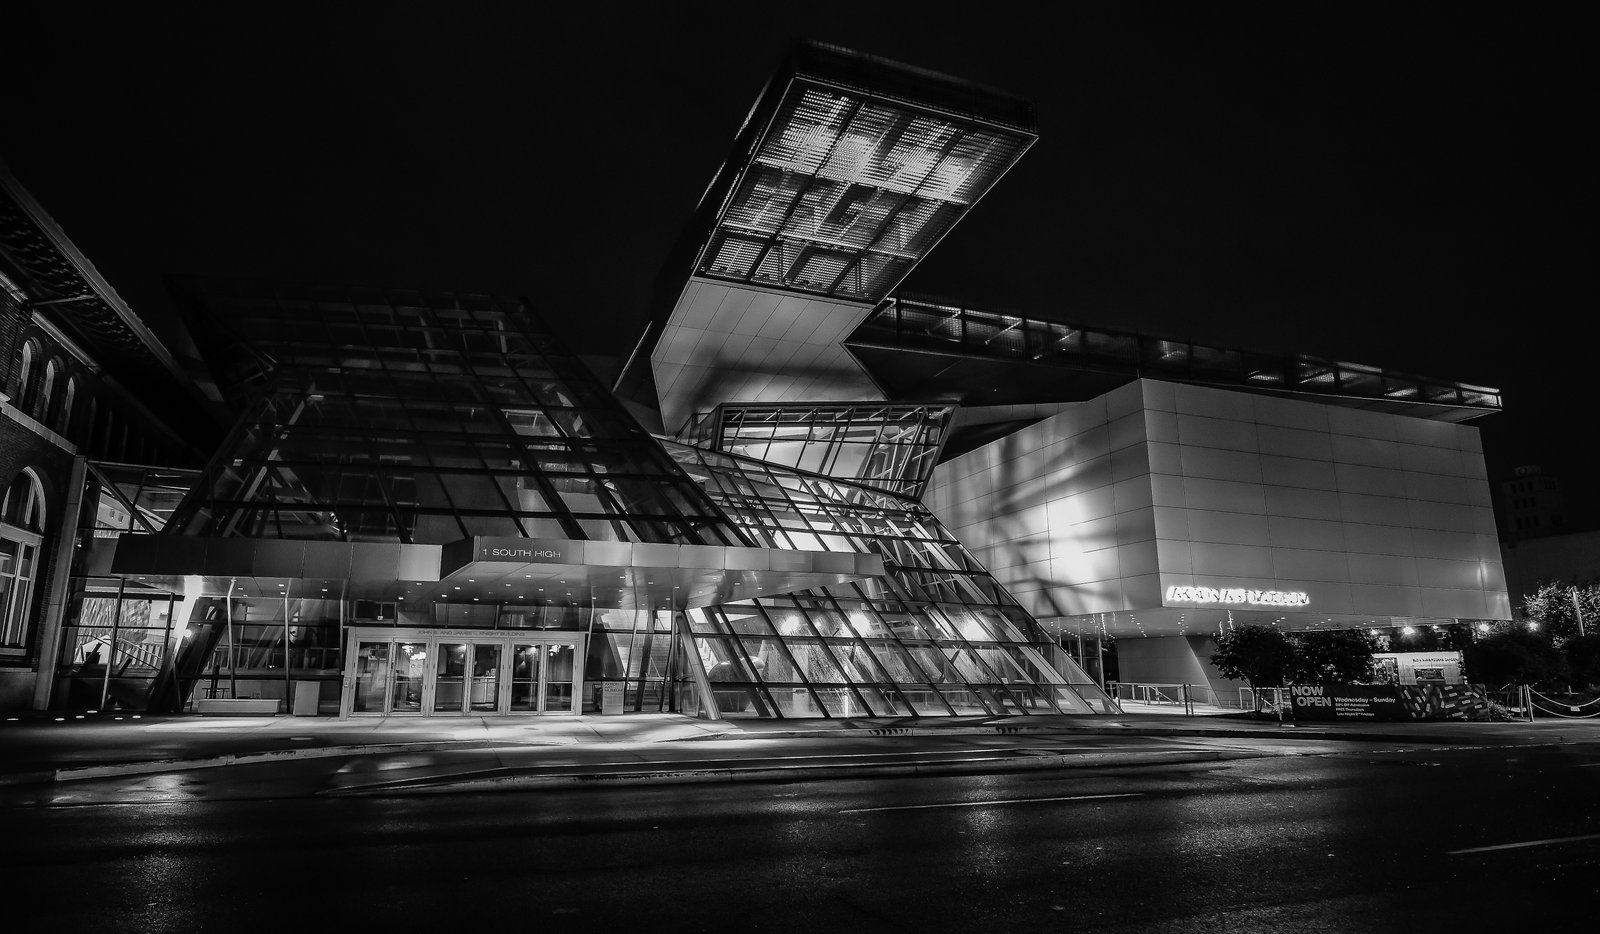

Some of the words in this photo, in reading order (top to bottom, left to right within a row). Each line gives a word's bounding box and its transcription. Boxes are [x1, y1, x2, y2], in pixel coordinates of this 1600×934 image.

[482, 548, 488, 556] 1
[492, 548, 532, 557] SOUTH
[534, 550, 561, 558] HIGH
[1291, 686, 1324, 696] NOW
[1296, 697, 1332, 707] OPEN
